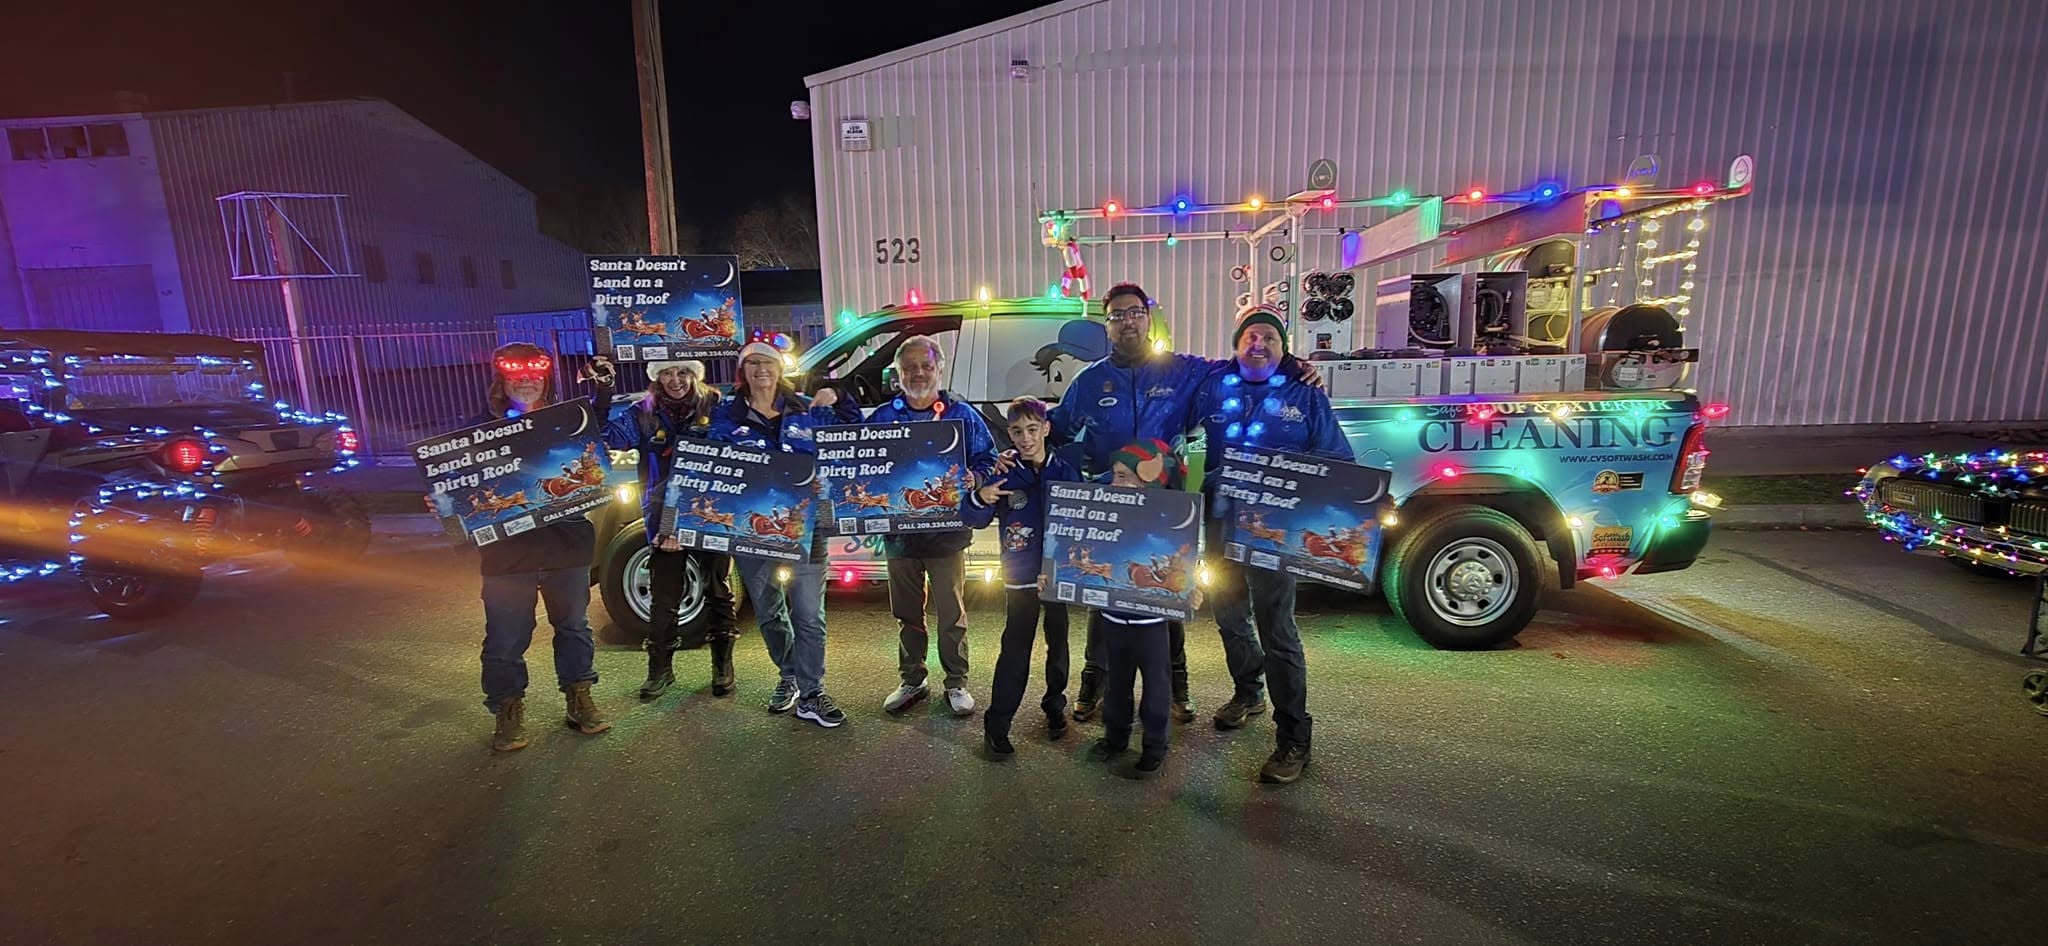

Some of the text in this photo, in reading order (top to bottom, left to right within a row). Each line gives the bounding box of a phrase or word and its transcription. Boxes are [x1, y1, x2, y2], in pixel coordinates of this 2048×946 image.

[875, 238, 920, 264] 523
[590, 257, 687, 272] Santa Doesn't
[592, 276, 664, 288] Land on a
[595, 292, 671, 307] Dirty Roof
[1426, 405, 1463, 417] Safe
[1534, 402, 1552, 413] &
[416, 417, 534, 460] Santa Doesn't
[815, 427, 911, 443] Santa Doesn't
[1418, 416, 1675, 453] CLEANING
[425, 444, 512, 478] Land on a
[677, 440, 772, 465] Santa Doesn't
[817, 446, 887, 460] Land on a
[1224, 447, 1331, 477] Santa Doesn't
[1560, 454, 1674, 463] WWW.CVSOFTWASH.COM
[433, 457, 522, 495] Dirty Roof
[674, 457, 744, 478] Land on a
[819, 462, 894, 480] Dirty Roof
[672, 474, 747, 495] Dirty Roof
[1221, 466, 1297, 491] Land on a
[1050, 485, 1146, 506] Santa Doesn't
[1219, 484, 1301, 510] Dirty Roof
[543, 513, 564, 522] CALL
[1049, 504, 1118, 523] Land on a
[1047, 523, 1122, 542] Dirty Roof
[736, 545, 754, 554] CALL
